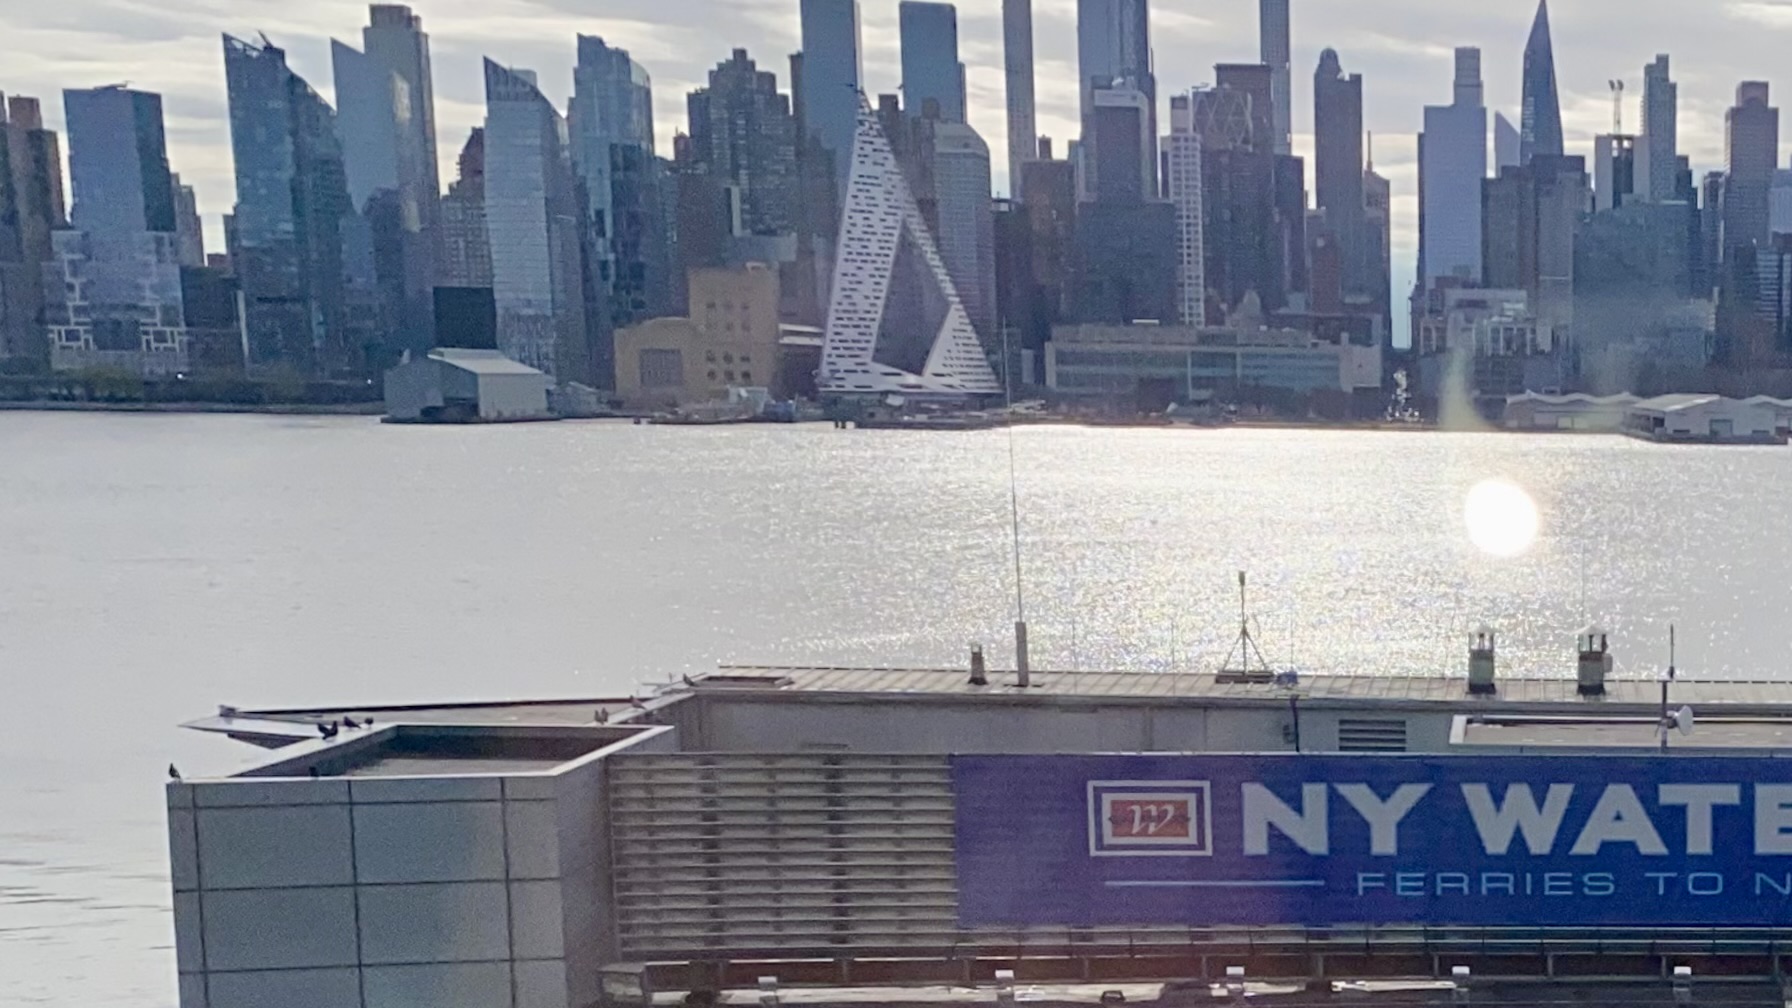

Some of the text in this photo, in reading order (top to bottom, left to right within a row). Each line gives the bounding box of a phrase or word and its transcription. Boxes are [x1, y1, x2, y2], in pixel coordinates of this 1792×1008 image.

[1241, 782, 1434, 856] NY
[1357, 871, 1615, 897] FERRIES
[1645, 871, 1724, 896] TO
